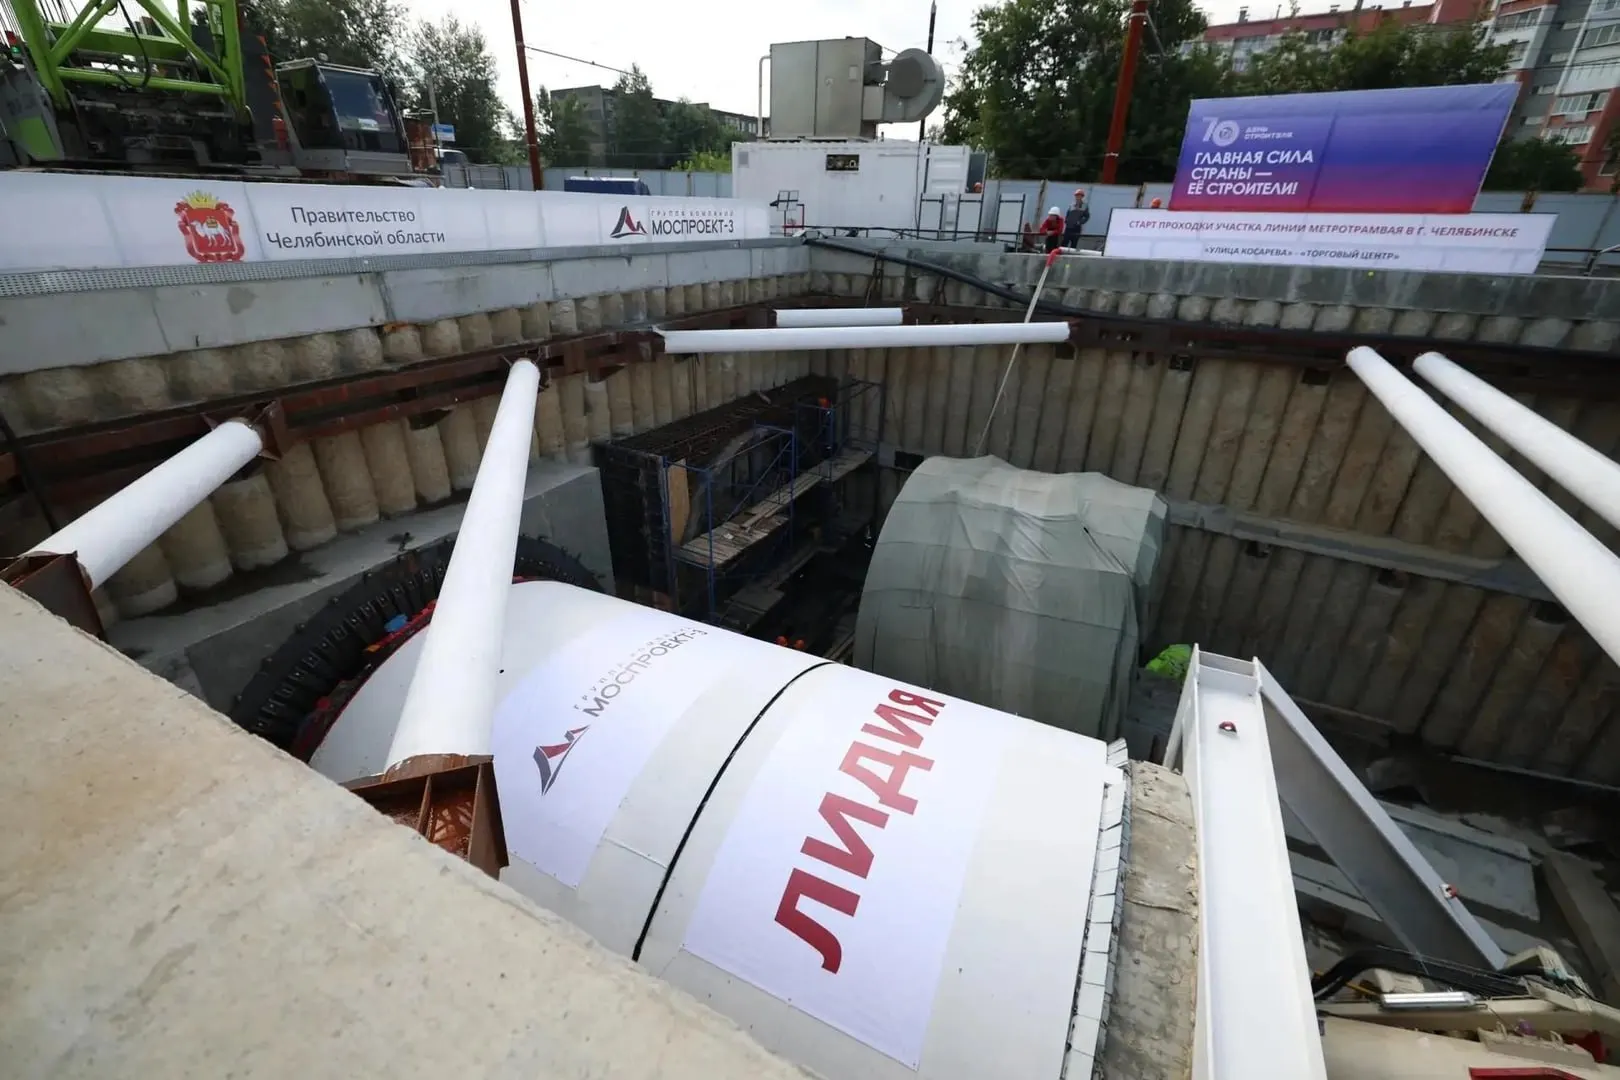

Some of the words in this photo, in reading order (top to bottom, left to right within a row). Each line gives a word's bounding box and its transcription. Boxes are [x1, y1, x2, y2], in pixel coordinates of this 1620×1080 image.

[1202, 116, 1240, 147] 70
[1194, 151, 1263, 165] ГЛАВНАЯ
[1266, 149, 1313, 164] СИЛА
[1191, 167, 1252, 181] СТРАНЫ
[1187, 179, 1204, 195] ЕЁ
[1206, 182, 1299, 195] СТРОИТЕЛИ!
[290, 206, 416, 226] Правительство
[652, 219, 734, 236] МОСПРОЕКТ-3
[1128, 220, 1157, 229] СТАРТ
[1158, 221, 1214, 232] ПРОХОДКИ
[1215, 222, 1262, 232] УЧАСТКА
[1263, 223, 1306, 233] ЛИНИИ
[1308, 224, 1406, 235] МЕТРОТРАМВАЯ
[1431, 227, 1519, 238] ЧЕЛЯБИНСКЕ
[266, 230, 383, 249] Челябинской
[386, 229, 445, 245] области
[1204, 246, 1240, 255] «УЛИЦА
[1241, 247, 1292, 257] КОСАРЕВА»
[1300, 249, 1360, 259] «ТОРГОВЫЙ
[1360, 251, 1400, 260] ЦЕНТР»
[582, 628, 708, 717] МОСПРОЕКТ-3
[774, 688, 946, 975] ЛИДИЯ
